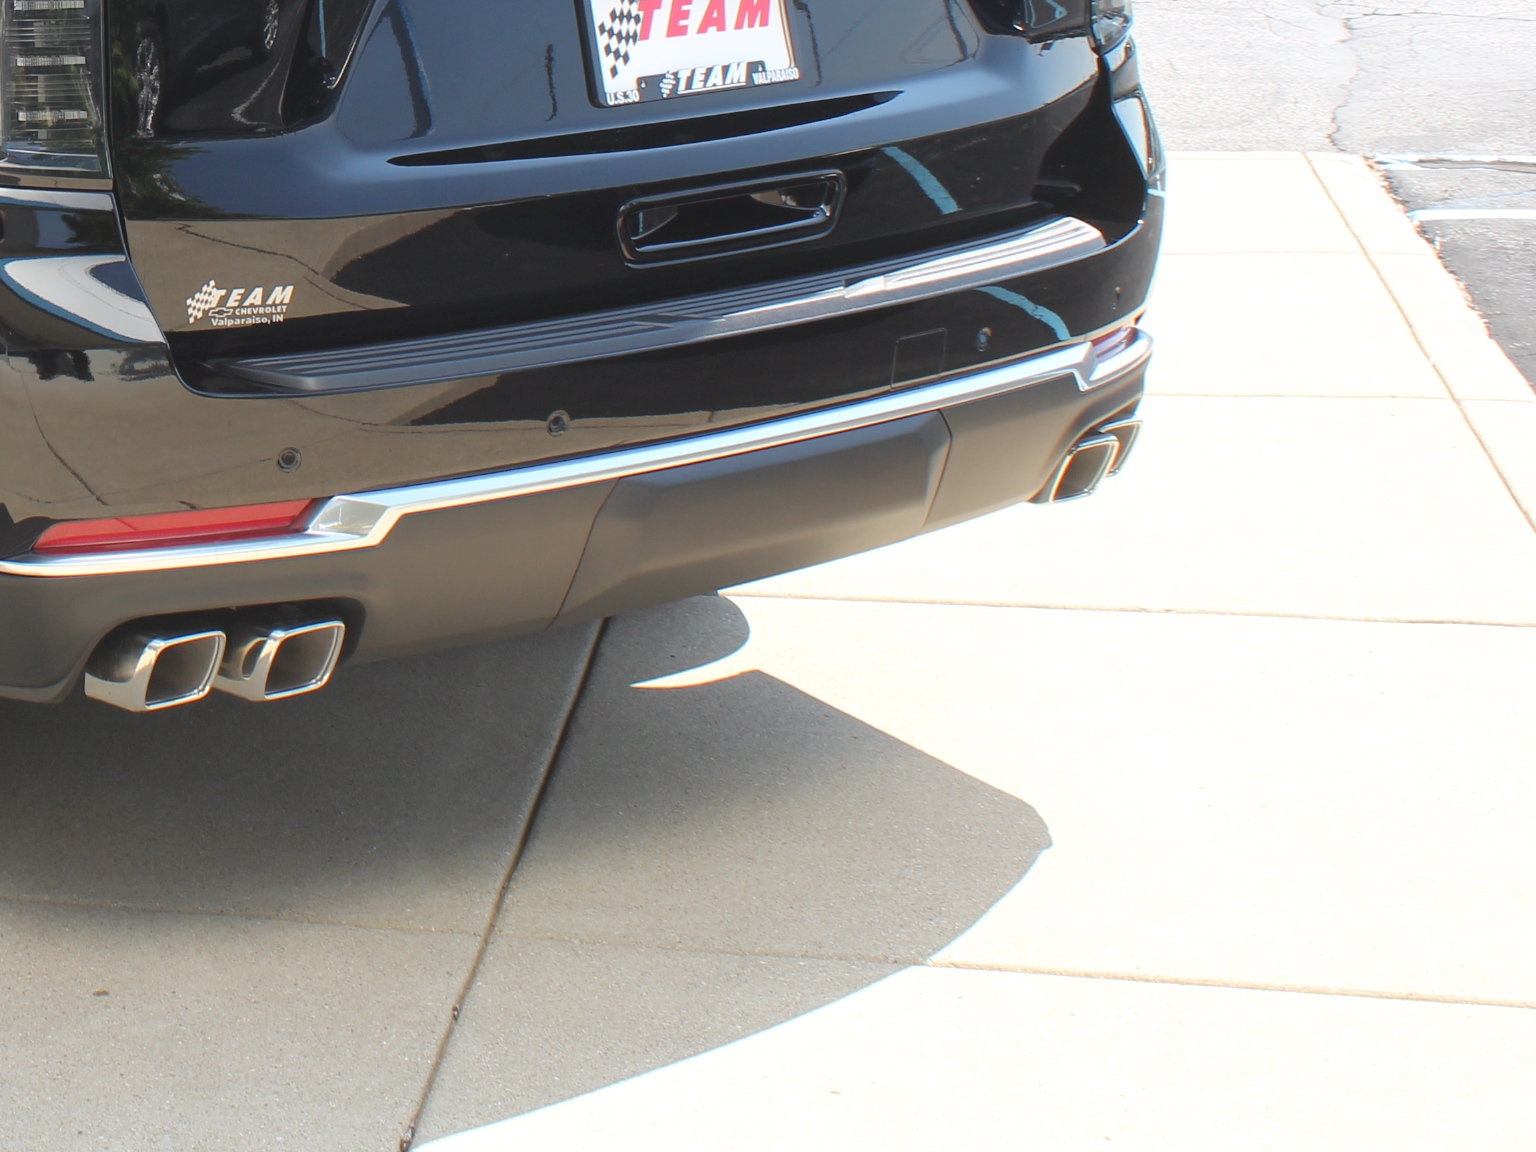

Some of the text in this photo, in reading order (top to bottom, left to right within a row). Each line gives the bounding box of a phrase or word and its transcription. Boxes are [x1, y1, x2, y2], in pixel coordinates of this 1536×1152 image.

[677, 61, 748, 93] TEAM
[751, 67, 800, 85] VALPARAISO
[212, 285, 295, 308] TEAM
[235, 305, 287, 316] CHEVROLET
[211, 313, 284, 327] Valparaiso, IN
